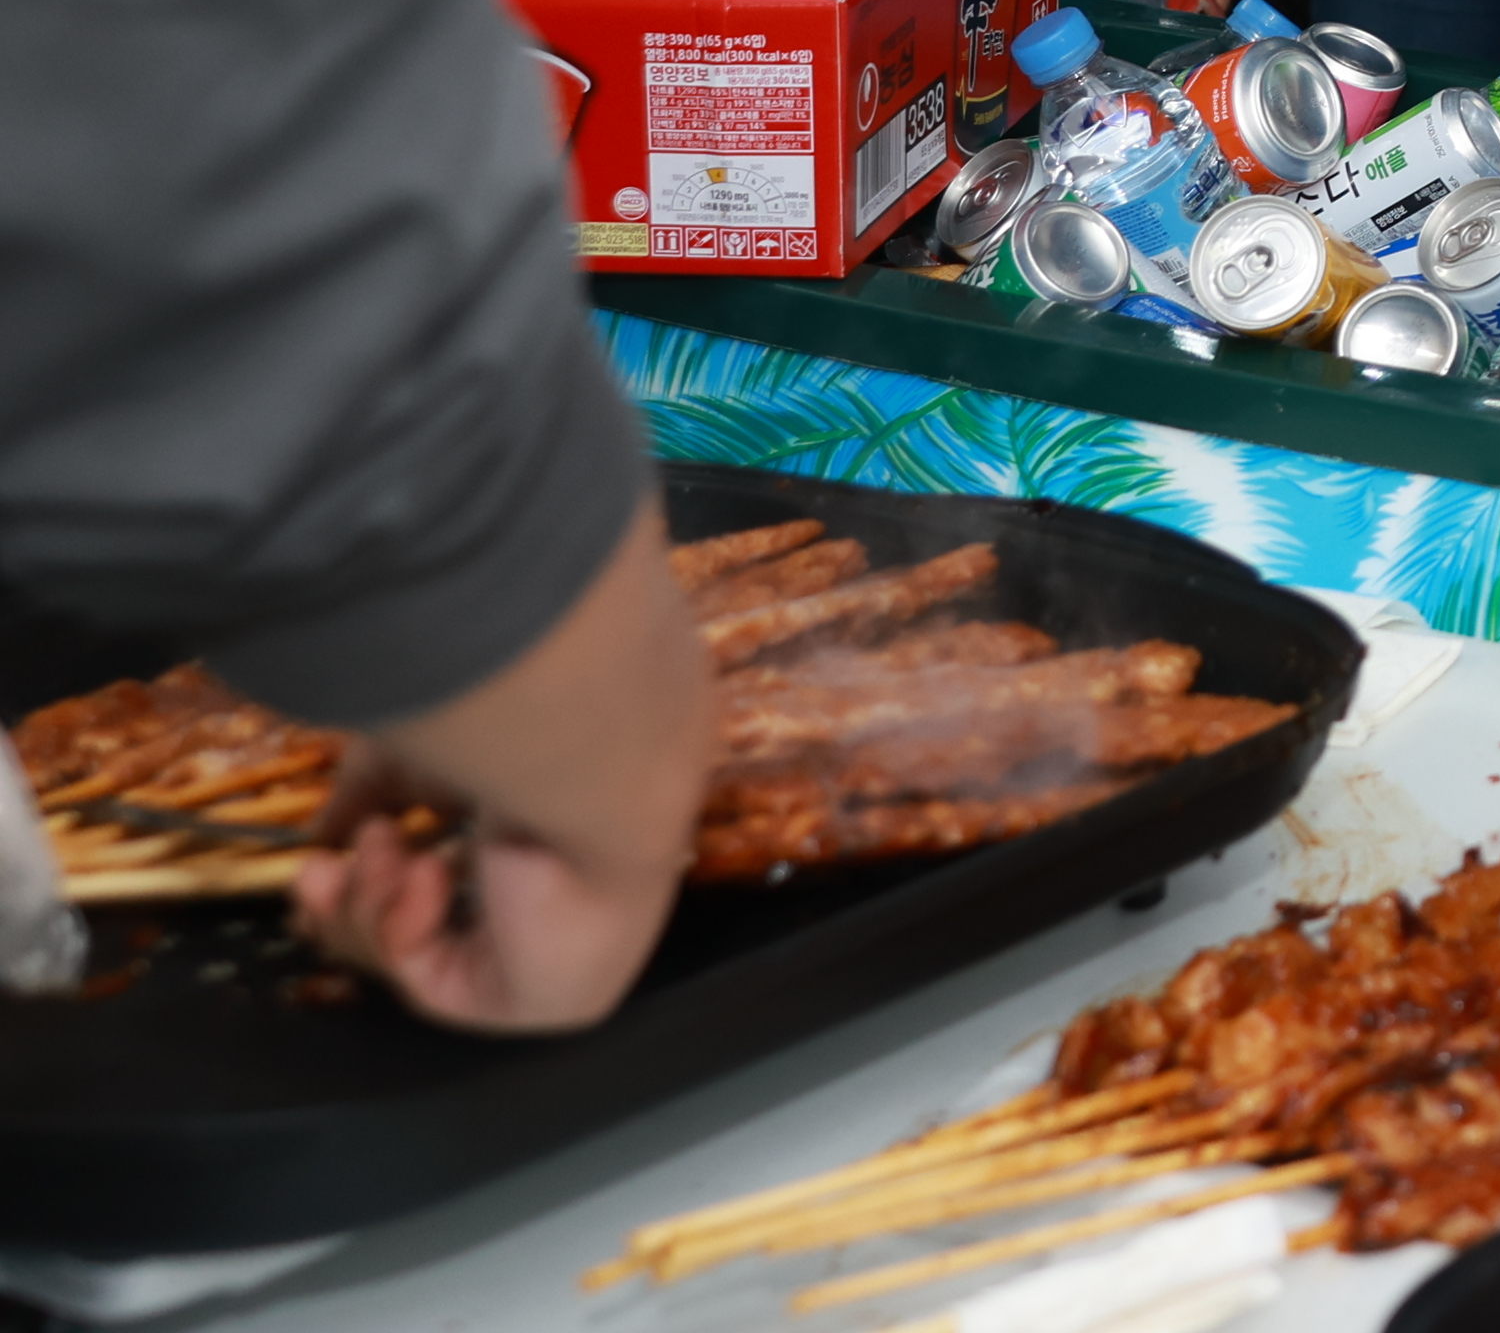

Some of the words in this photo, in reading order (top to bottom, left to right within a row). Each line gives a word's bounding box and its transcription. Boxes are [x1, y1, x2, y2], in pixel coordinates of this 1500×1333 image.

[650, 65, 711, 83] 영양정보
[704, 49, 754, 63] kcal(300
[908, 81, 945, 146] 3538
[1212, 87, 1221, 123] Orange
[1221, 75, 1229, 120] Flavored
[1365, 144, 1409, 182] 애플
[710, 190, 732, 200] 1290
[734, 191, 749, 203] mg
